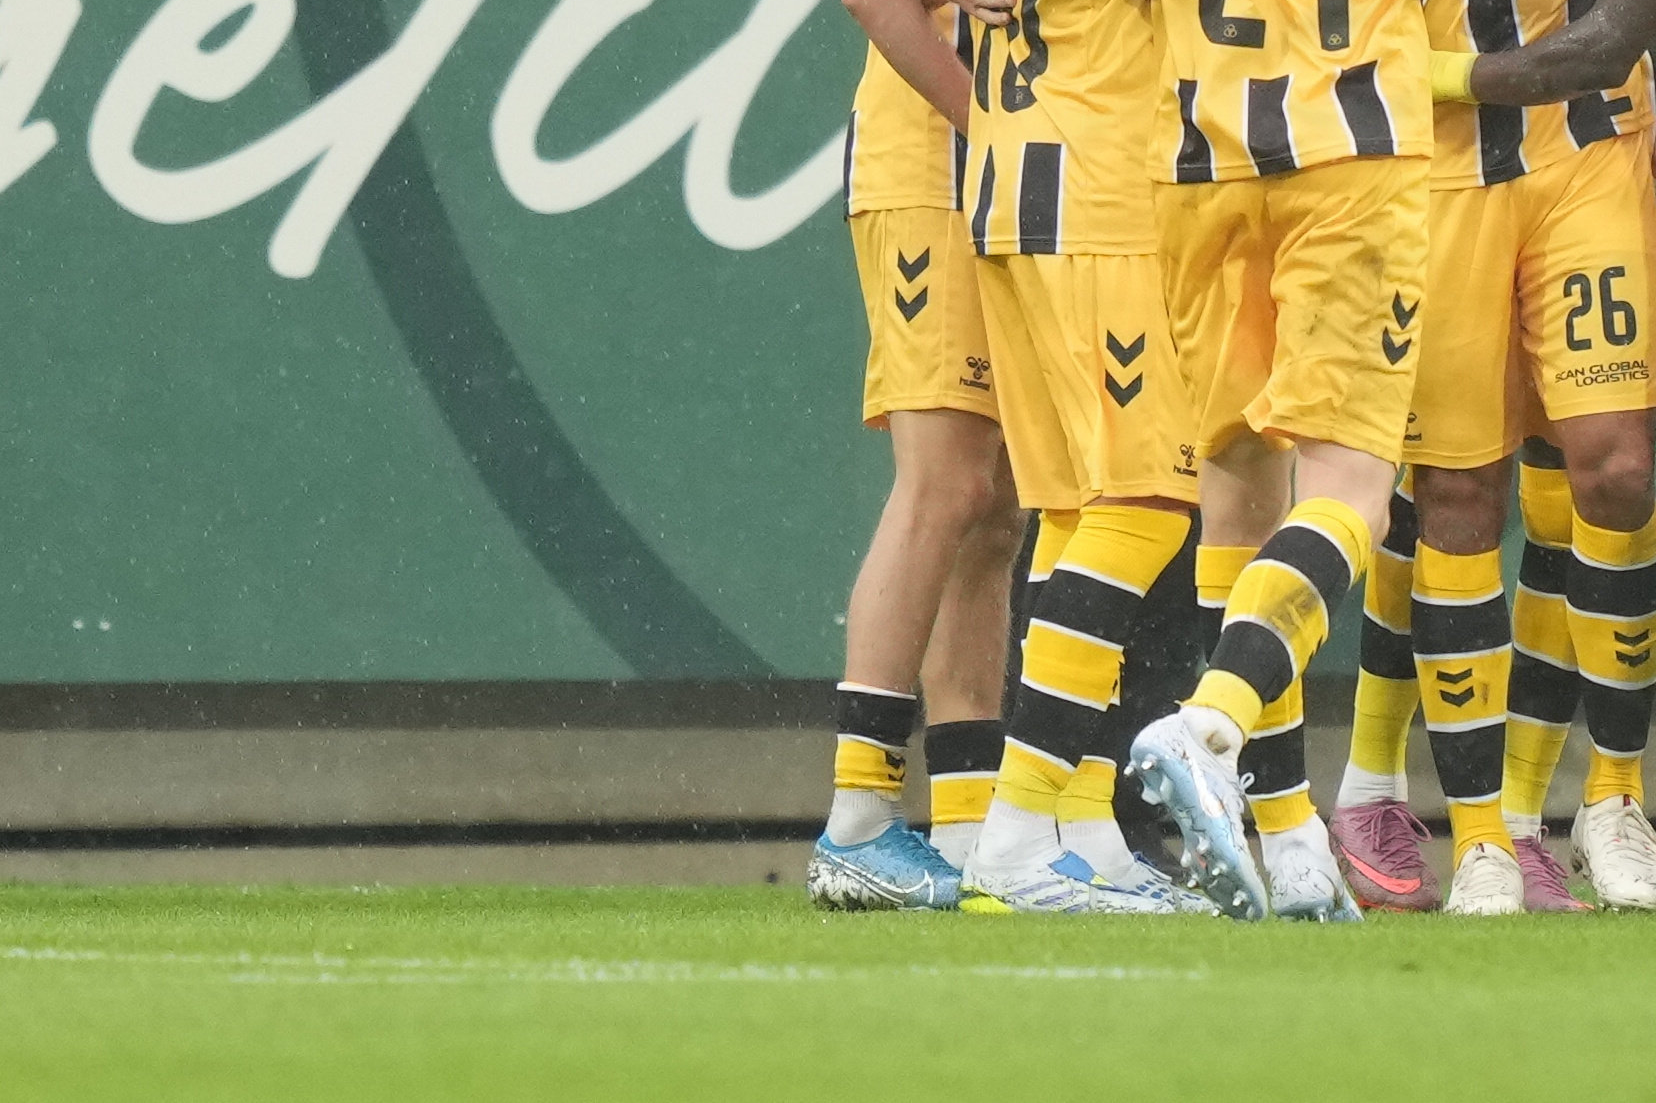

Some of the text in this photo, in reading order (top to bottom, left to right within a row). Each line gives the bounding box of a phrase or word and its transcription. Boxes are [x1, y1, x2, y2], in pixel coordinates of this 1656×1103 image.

[1563, 266, 1637, 352] 26
[1555, 360, 1648, 384] SCAN GLOBAL
[1575, 369, 1650, 388] LOGISTICS
